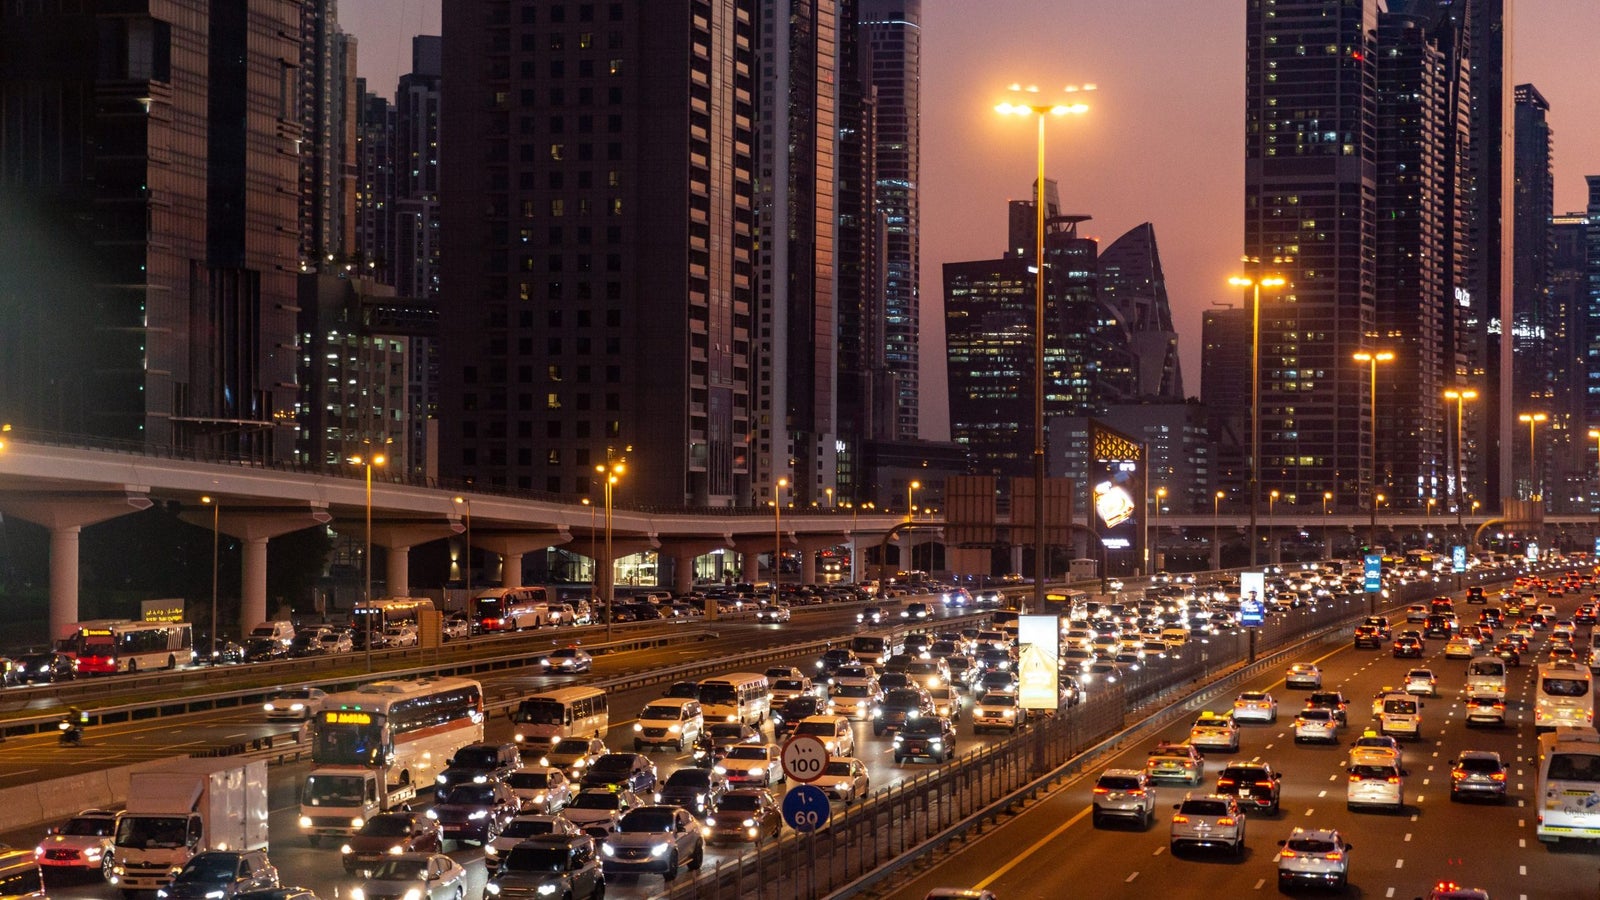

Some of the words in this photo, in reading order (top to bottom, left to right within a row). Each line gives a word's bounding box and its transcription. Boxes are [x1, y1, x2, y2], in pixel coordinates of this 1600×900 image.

[794, 743, 812, 755] ١٠٠
[790, 759, 820, 772] 100
[797, 792, 813, 805] ٦٠
[795, 811, 818, 825] 60
